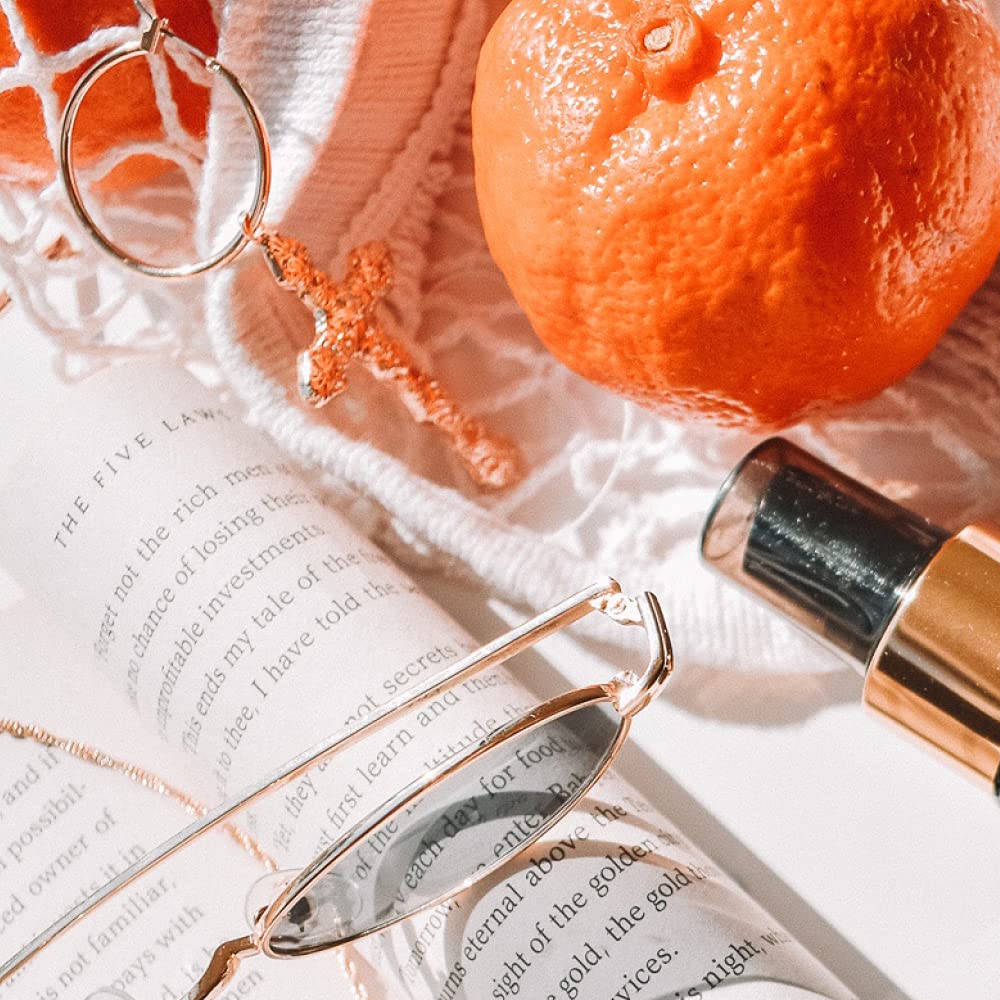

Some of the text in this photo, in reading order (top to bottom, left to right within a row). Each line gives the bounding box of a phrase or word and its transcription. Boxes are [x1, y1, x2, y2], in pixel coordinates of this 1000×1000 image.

[54, 432, 152, 549] THE FIVE
[114, 484, 218, 601] not the rich
[132, 507, 265, 659] chance of losing
[198, 523, 326, 622] investments
[196, 564, 320, 718] ends my tale of
[262, 592, 363, 683] have told
[382, 644, 458, 697] secrets
[287, 772, 318, 820] they
[326, 690, 460, 829] first learn and
[28, 837, 89, 897] owner
[95, 806, 118, 835] of
[367, 822, 399, 855] the
[404, 841, 444, 890] each
[442, 795, 479, 838] day
[479, 768, 516, 798] for
[515, 732, 564, 770] food
[525, 824, 590, 888] above
[57, 952, 92, 988] not
[88, 877, 177, 953] familiar,
[463, 883, 524, 962] eternal
[530, 921, 553, 954] of
[549, 891, 588, 929] the
[589, 841, 657, 897] golden
[559, 942, 611, 1000] gold,
[605, 904, 645, 942] the
[646, 871, 692, 912] gold
[112, 950, 156, 992] pays
[157, 903, 204, 950] with
[702, 940, 768, 990] night,
